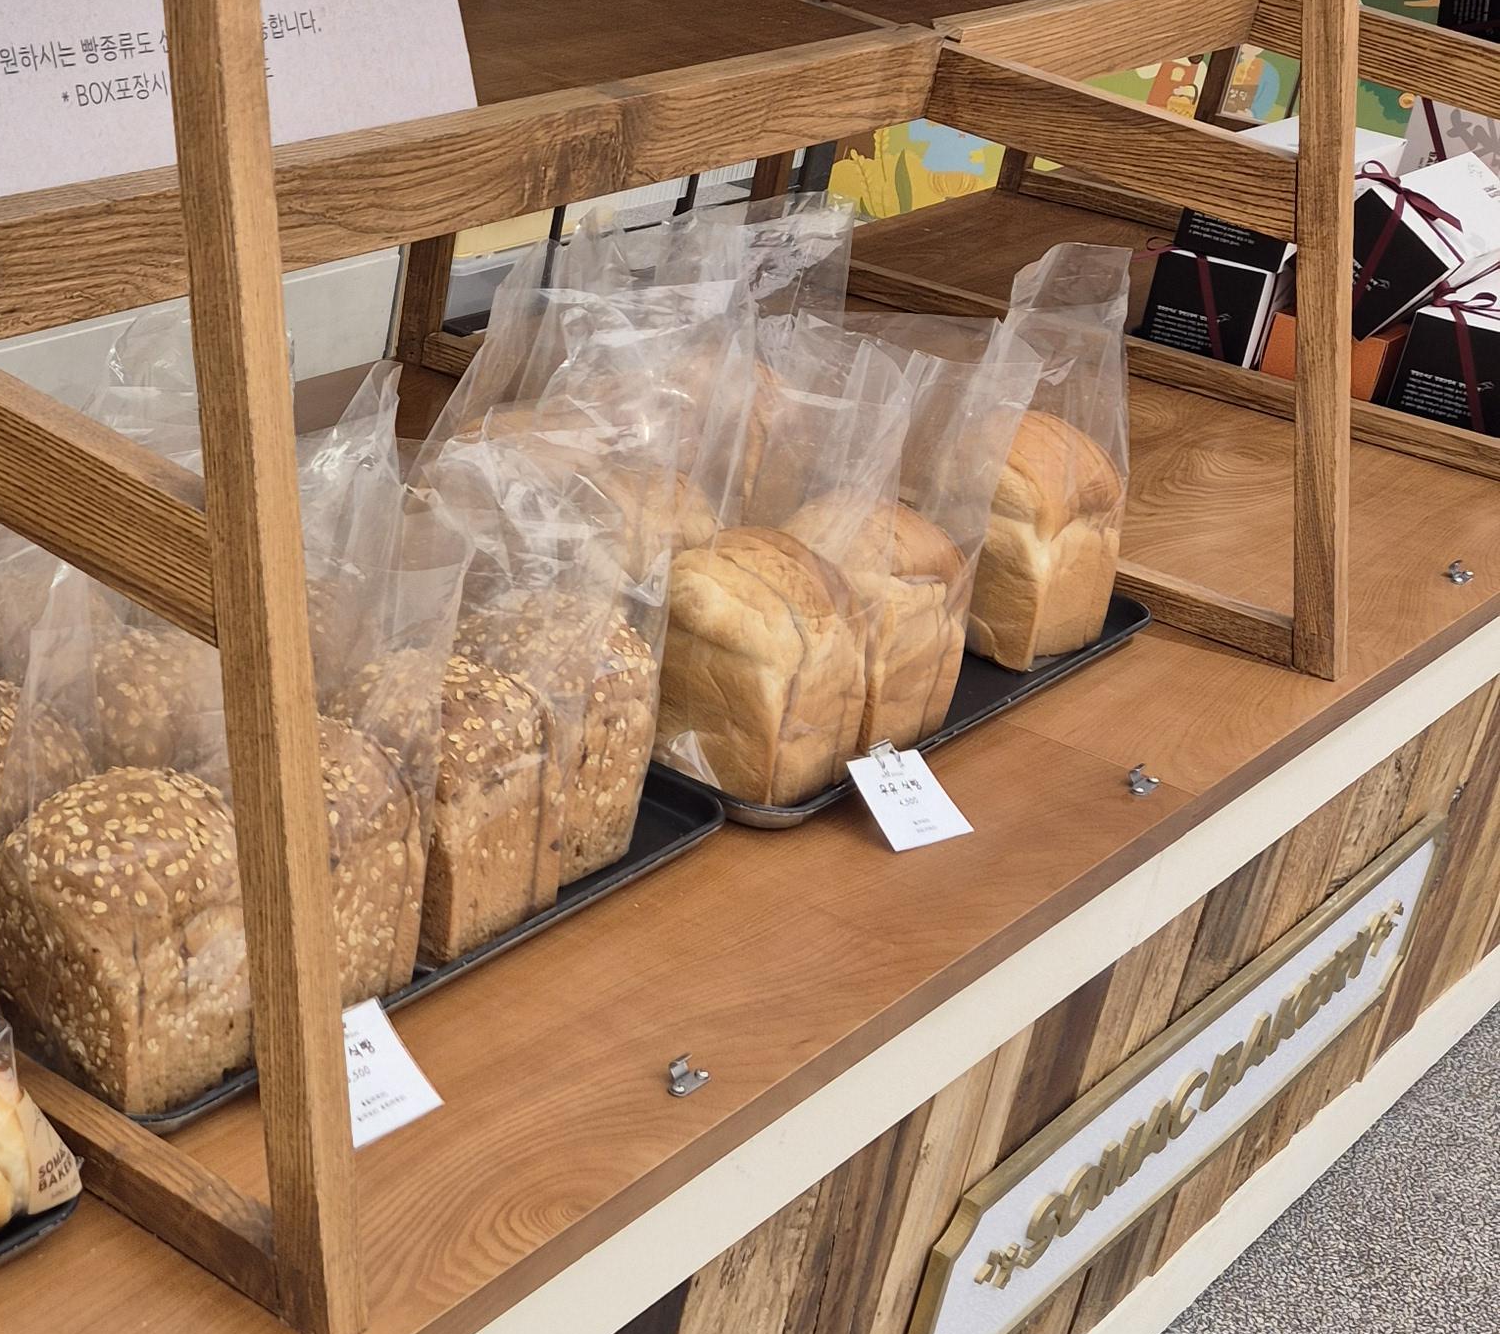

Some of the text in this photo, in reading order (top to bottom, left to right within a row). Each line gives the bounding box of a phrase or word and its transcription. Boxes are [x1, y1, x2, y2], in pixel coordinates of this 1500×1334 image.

[80, 31, 156, 64] 빵종류도
[74, 70, 169, 107] BOX포장시
[1017, 1069, 1209, 1267] SOMAC
